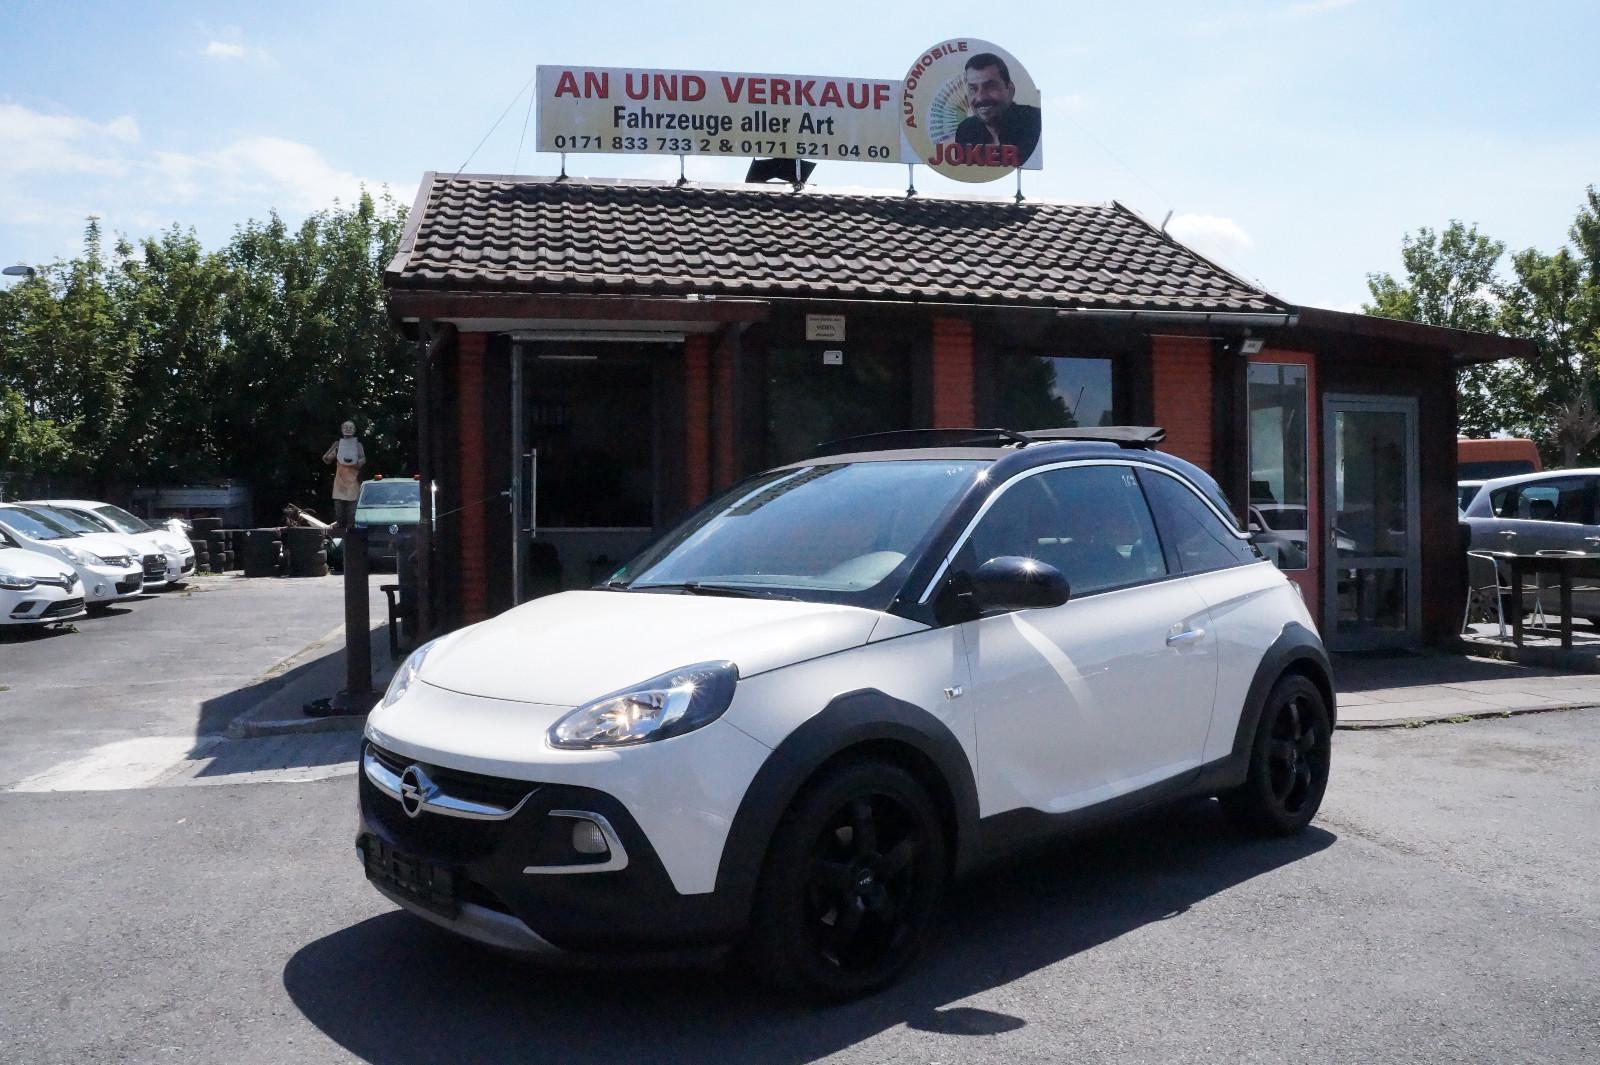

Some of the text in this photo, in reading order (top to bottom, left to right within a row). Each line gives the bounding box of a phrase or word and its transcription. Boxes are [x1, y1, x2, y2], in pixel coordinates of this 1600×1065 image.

[554, 70, 890, 110] AN UND VERKAUF
[903, 41, 969, 129] AUTOMOBILE
[613, 105, 834, 136] Fahrzeuge aller Art
[554, 135, 890, 159] 0171 833 733 2 & 0171 521 04 60
[927, 143, 1021, 168] JOKER
